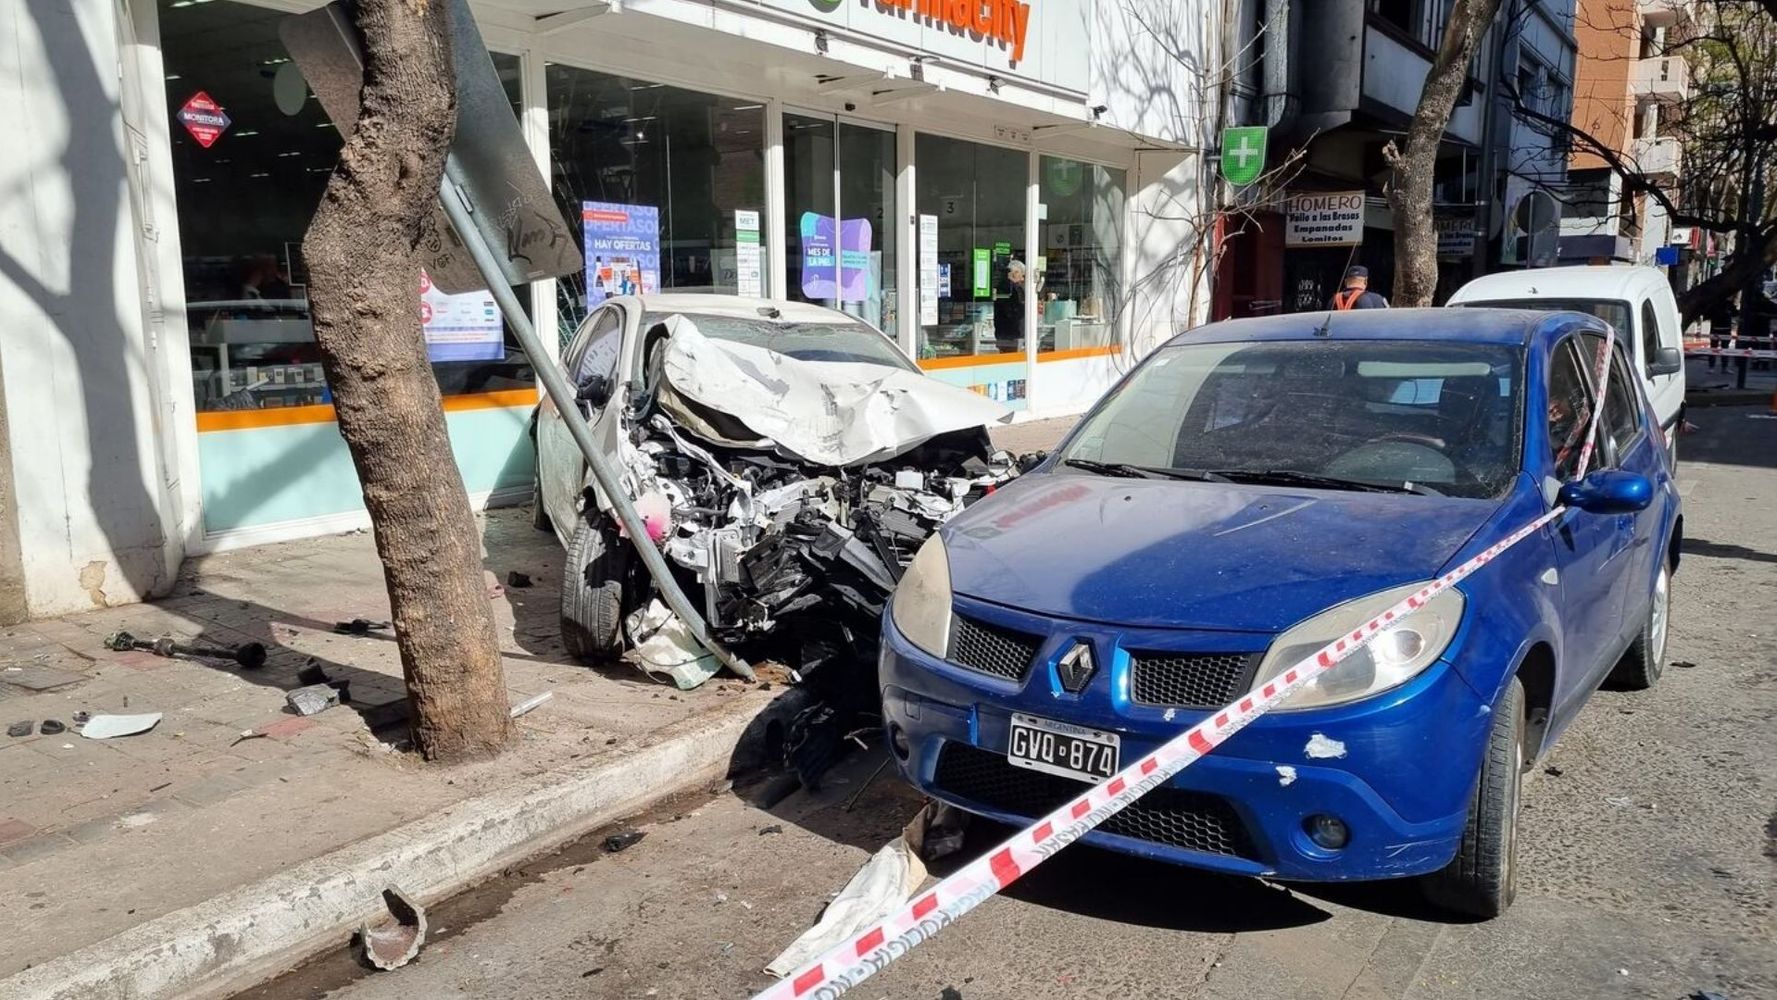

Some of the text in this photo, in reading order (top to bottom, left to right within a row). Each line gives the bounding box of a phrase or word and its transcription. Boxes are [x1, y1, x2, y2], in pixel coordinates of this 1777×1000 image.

[946, 201, 954, 214] 3
[1289, 195, 1362, 212] HOMERO
[1319, 212, 1331, 221] las
[1333, 212, 1360, 221] Brasas
[1294, 223, 1353, 234] Empanadas
[1302, 235, 1343, 243] Lomitos
[594, 239, 651, 251] HAY OFERTAS
[807, 247, 831, 256] MES DE
[1013, 727, 1055, 763] GVQ
[1070, 739, 1113, 777] 874
